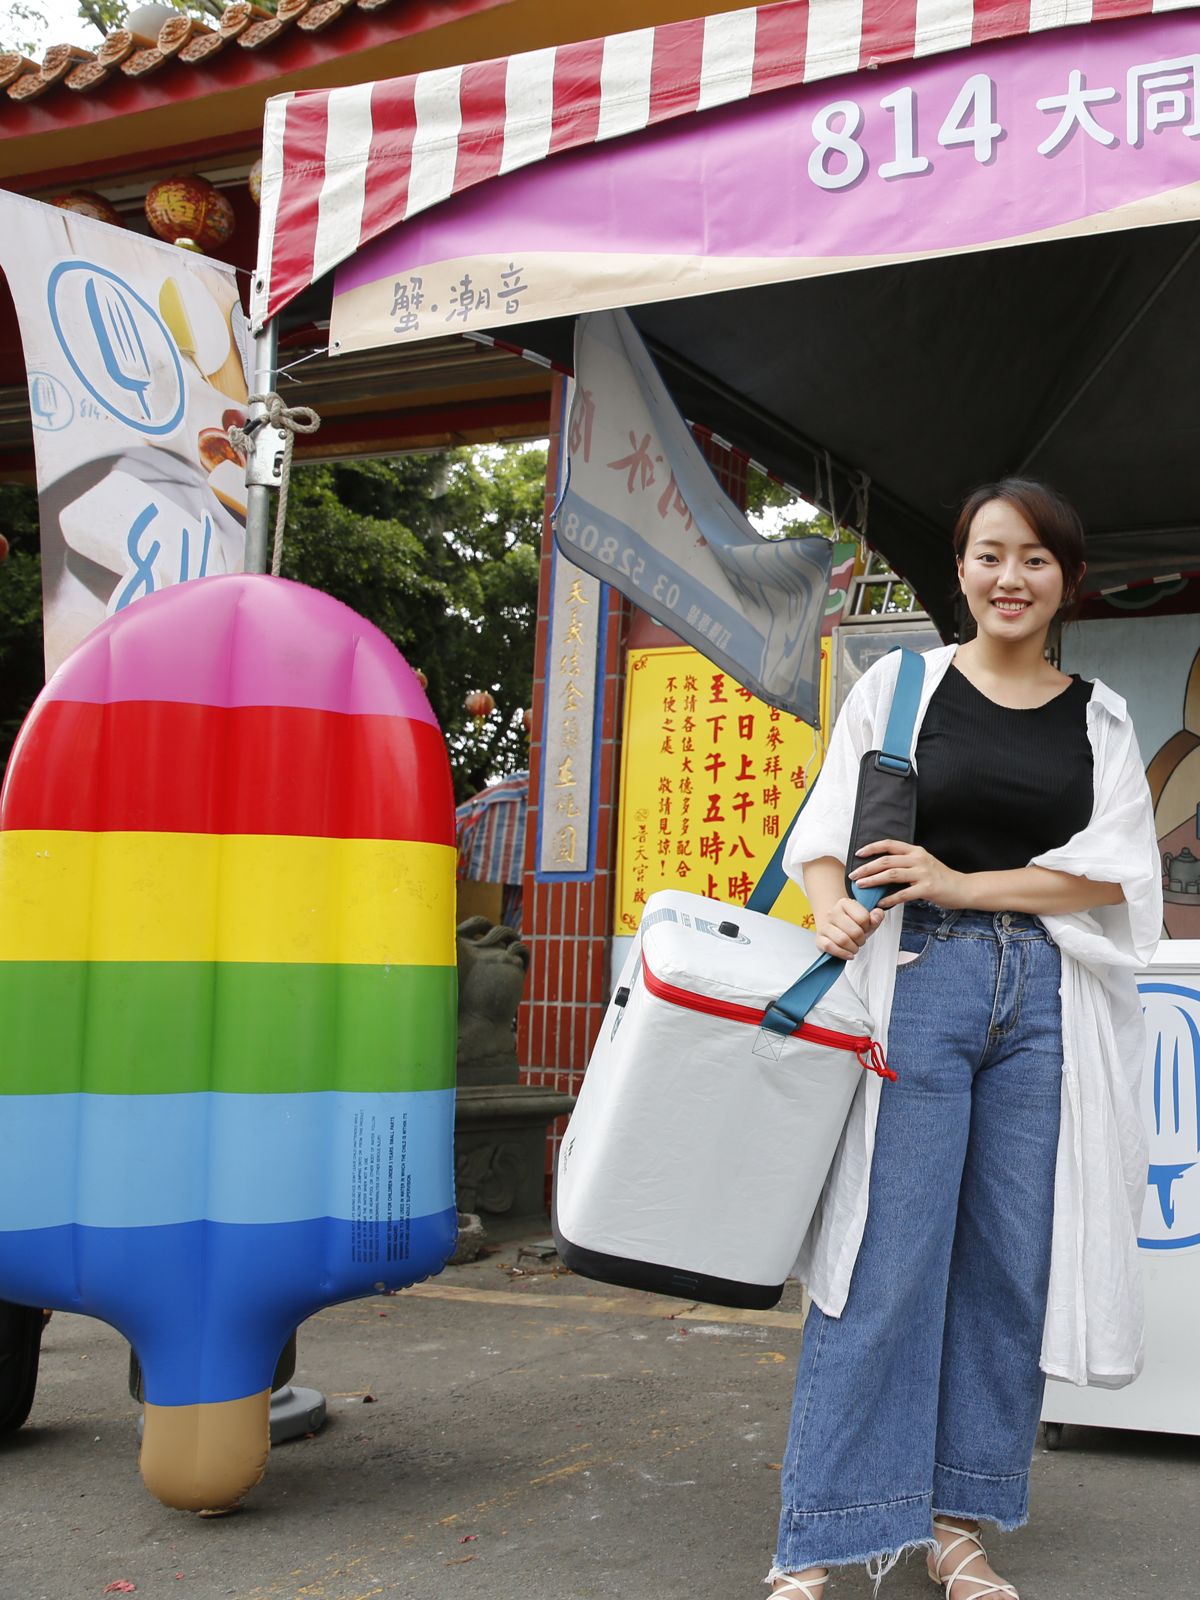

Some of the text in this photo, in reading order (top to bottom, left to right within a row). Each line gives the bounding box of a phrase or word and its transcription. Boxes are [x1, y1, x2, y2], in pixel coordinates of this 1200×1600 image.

[807, 73, 1004, 191] 814
[676, 675, 699, 877] 敬請各位大德多多配合
[700, 674, 728, 902] 至下午五時止
